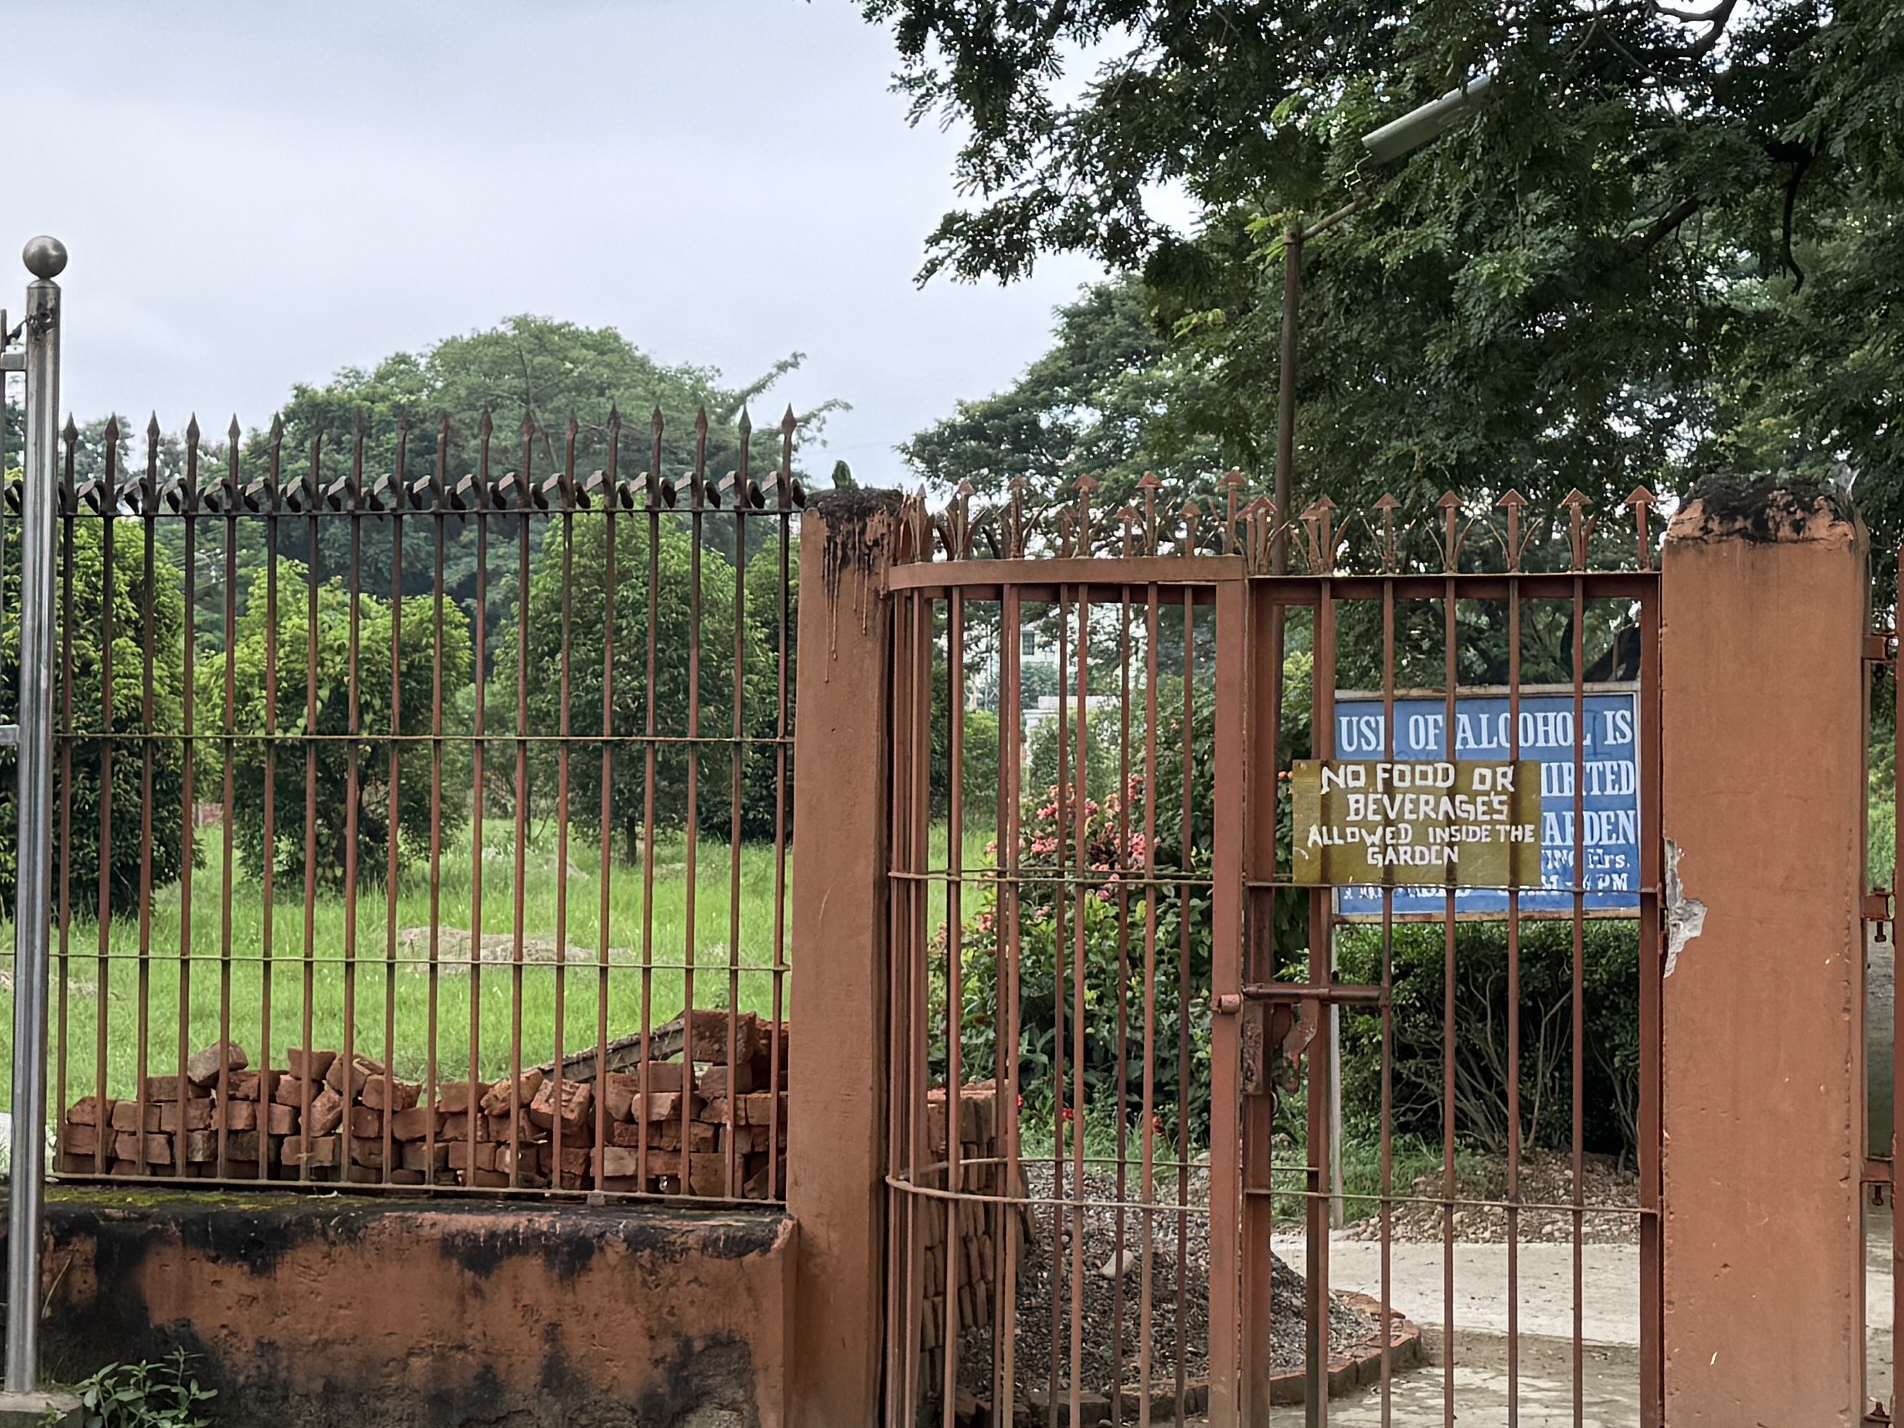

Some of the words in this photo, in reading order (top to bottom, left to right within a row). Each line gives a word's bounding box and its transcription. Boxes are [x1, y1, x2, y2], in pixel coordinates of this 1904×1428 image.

[1408, 714, 1443, 750] OF
[1603, 709, 1633, 745] IS
[1321, 764, 1366, 795] NO
[1376, 762, 1456, 793] FOOD
[1472, 765, 1515, 792] OR
[1346, 791, 1508, 821] BEVERAGE'S
[1307, 823, 1413, 847] ALLOWED
[1428, 825, 1491, 843] INSIDE
[1496, 824, 1536, 843] THE
[1367, 845, 1459, 867] GARDEN
